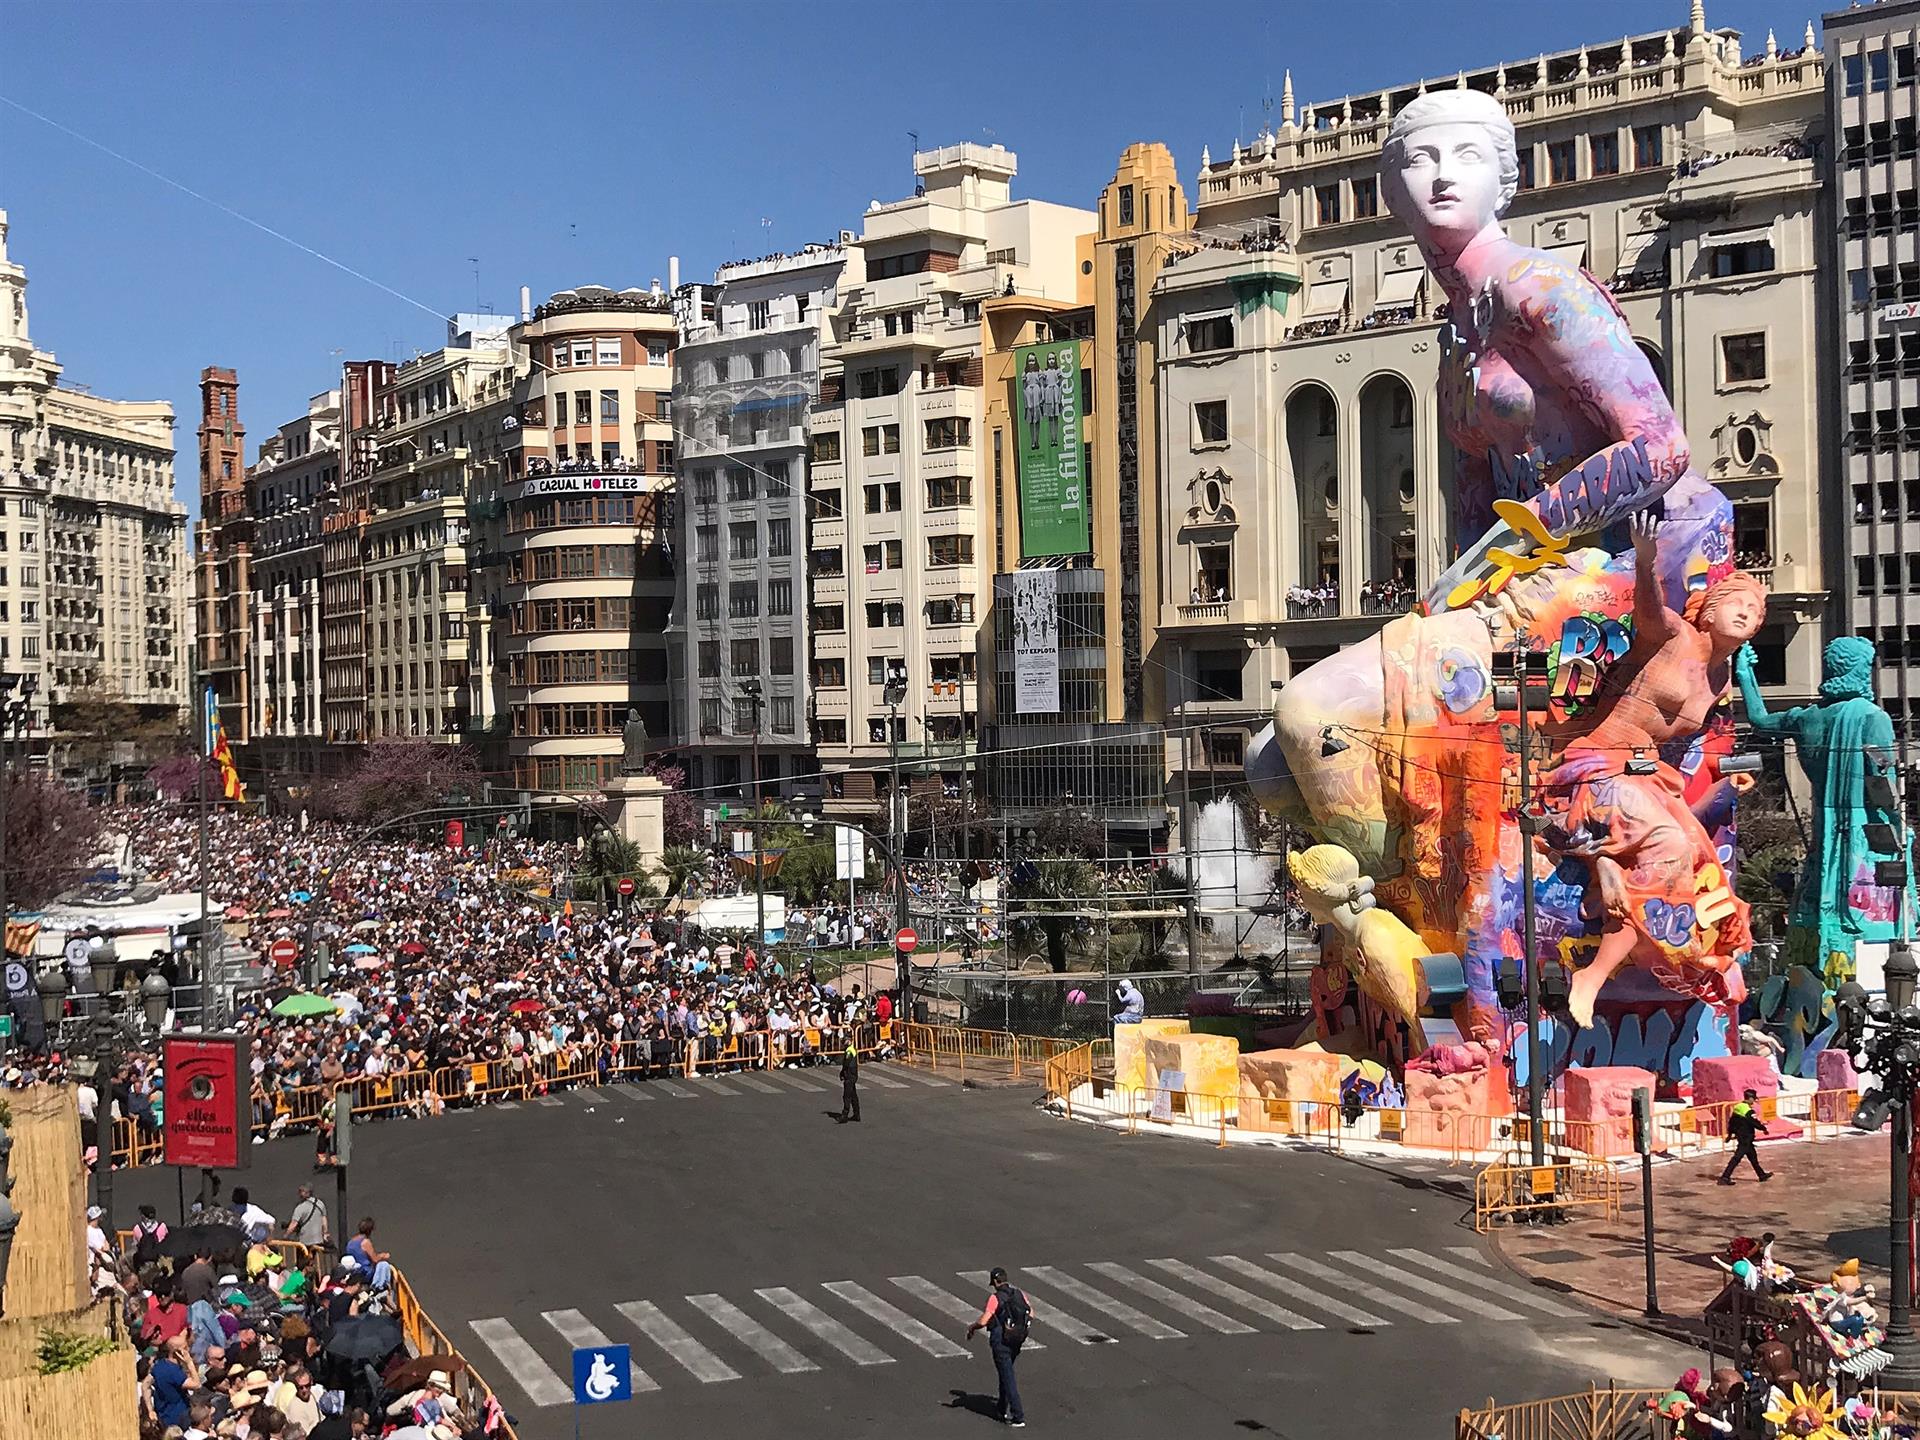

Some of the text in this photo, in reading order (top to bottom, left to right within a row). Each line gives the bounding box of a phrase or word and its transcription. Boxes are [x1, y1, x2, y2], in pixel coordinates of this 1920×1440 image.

[1118, 265, 1135, 377] RIALTO
[1058, 347, 1078, 480] filmoteca
[539, 478, 638, 492] CASUAL HOTELES
[1061, 484, 1080, 512] la
[187, 1108, 217, 1121] elles
